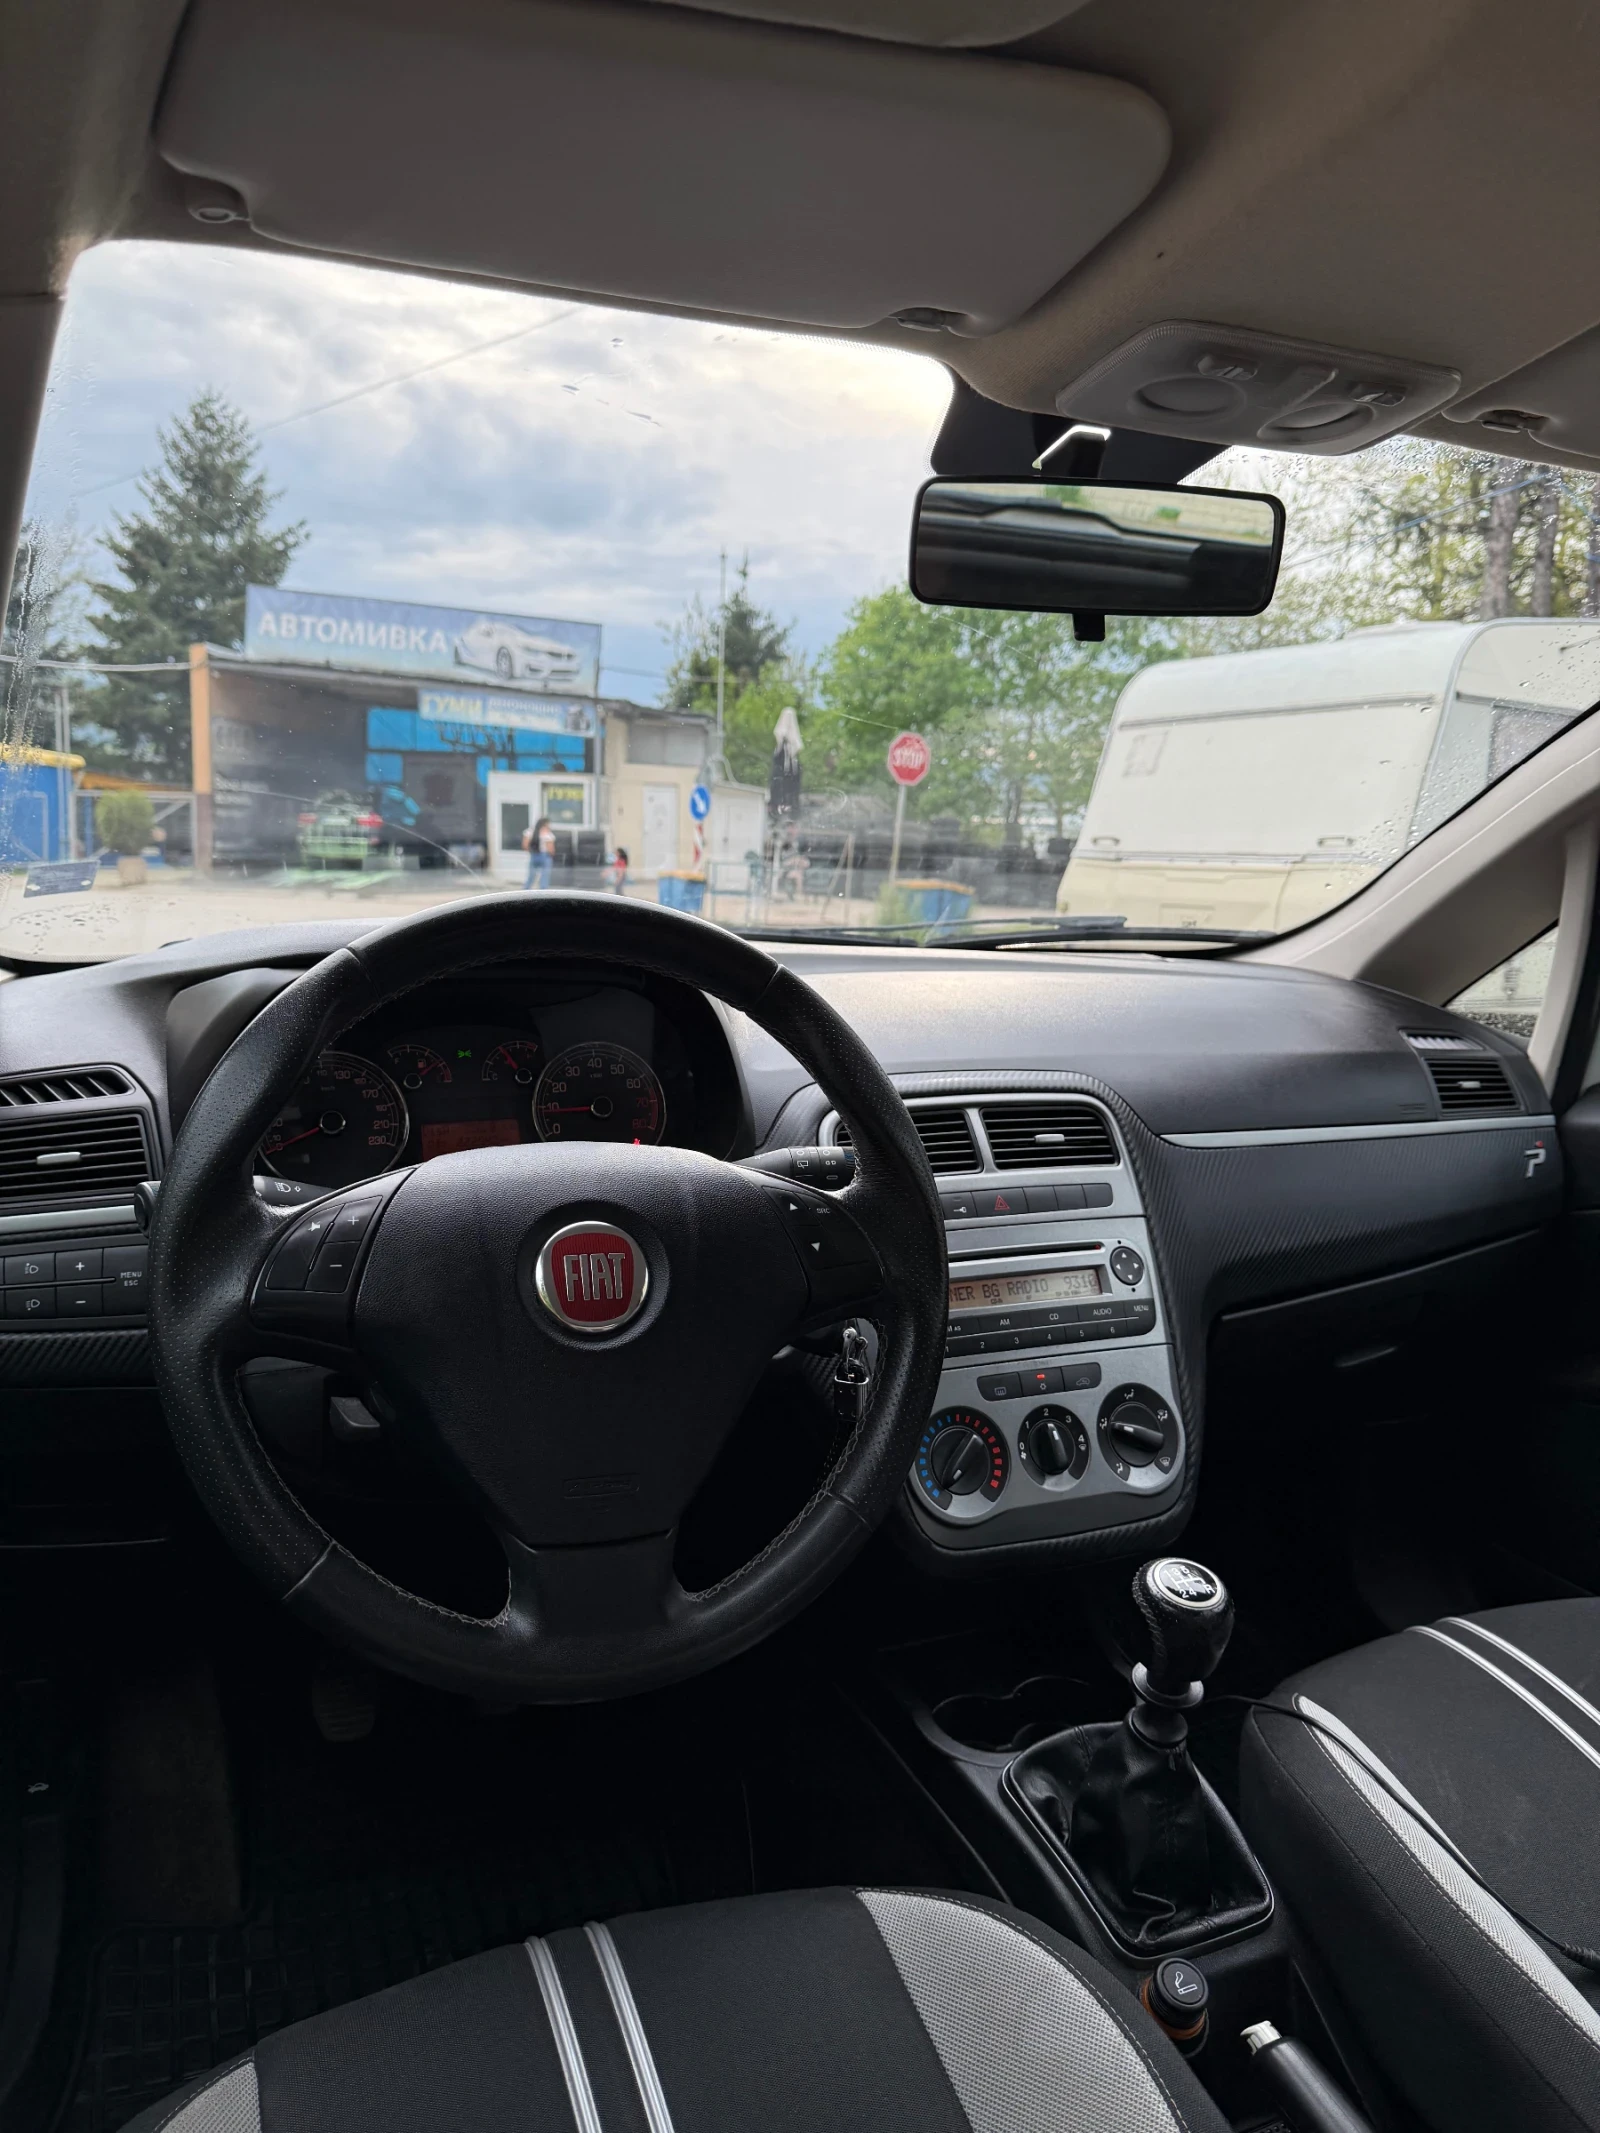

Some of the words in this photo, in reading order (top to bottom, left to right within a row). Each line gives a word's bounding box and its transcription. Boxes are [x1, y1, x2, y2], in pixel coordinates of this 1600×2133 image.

[258, 611, 448, 654] АВТОМИВКА
[587, 1057, 602, 1068] 40
[565, 1066, 580, 1077] 30
[610, 1064, 625, 1075] 50
[334, 1070, 351, 1080] 130
[552, 1082, 567, 1093] 20
[626, 1078, 641, 1089] 60
[362, 1089, 379, 1098] 170
[636, 1097, 648, 1107] 70
[373, 1119, 389, 1130] 210
[552, 1123, 561, 1134] 0
[368, 1135, 387, 1146] 230
[120, 1271, 142, 1279] MENU
[563, 1252, 626, 1301] FIAT
[982, 1283, 1000, 1298] BG
[1006, 1278, 1049, 1296] RADIO
[1092, 1307, 1112, 1316] AUDIO
[1133, 1304, 1149, 1312] MENU
[999, 1318, 1010, 1326] AM
[1110, 1326, 1115, 1334] 6
[980, 1341, 985, 1349] 2
[1043, 1408, 1049, 1416] 2
[1025, 1420, 1030, 1428] 1
[1065, 1415, 1072, 1423] 3
[1078, 1434, 1084, 1443] 4
[1019, 1442, 1025, 1450] 0
[1180, 1589, 1189, 1598] 2
[1189, 1588, 1197, 1596] 4
[1203, 1584, 1216, 1595] R
